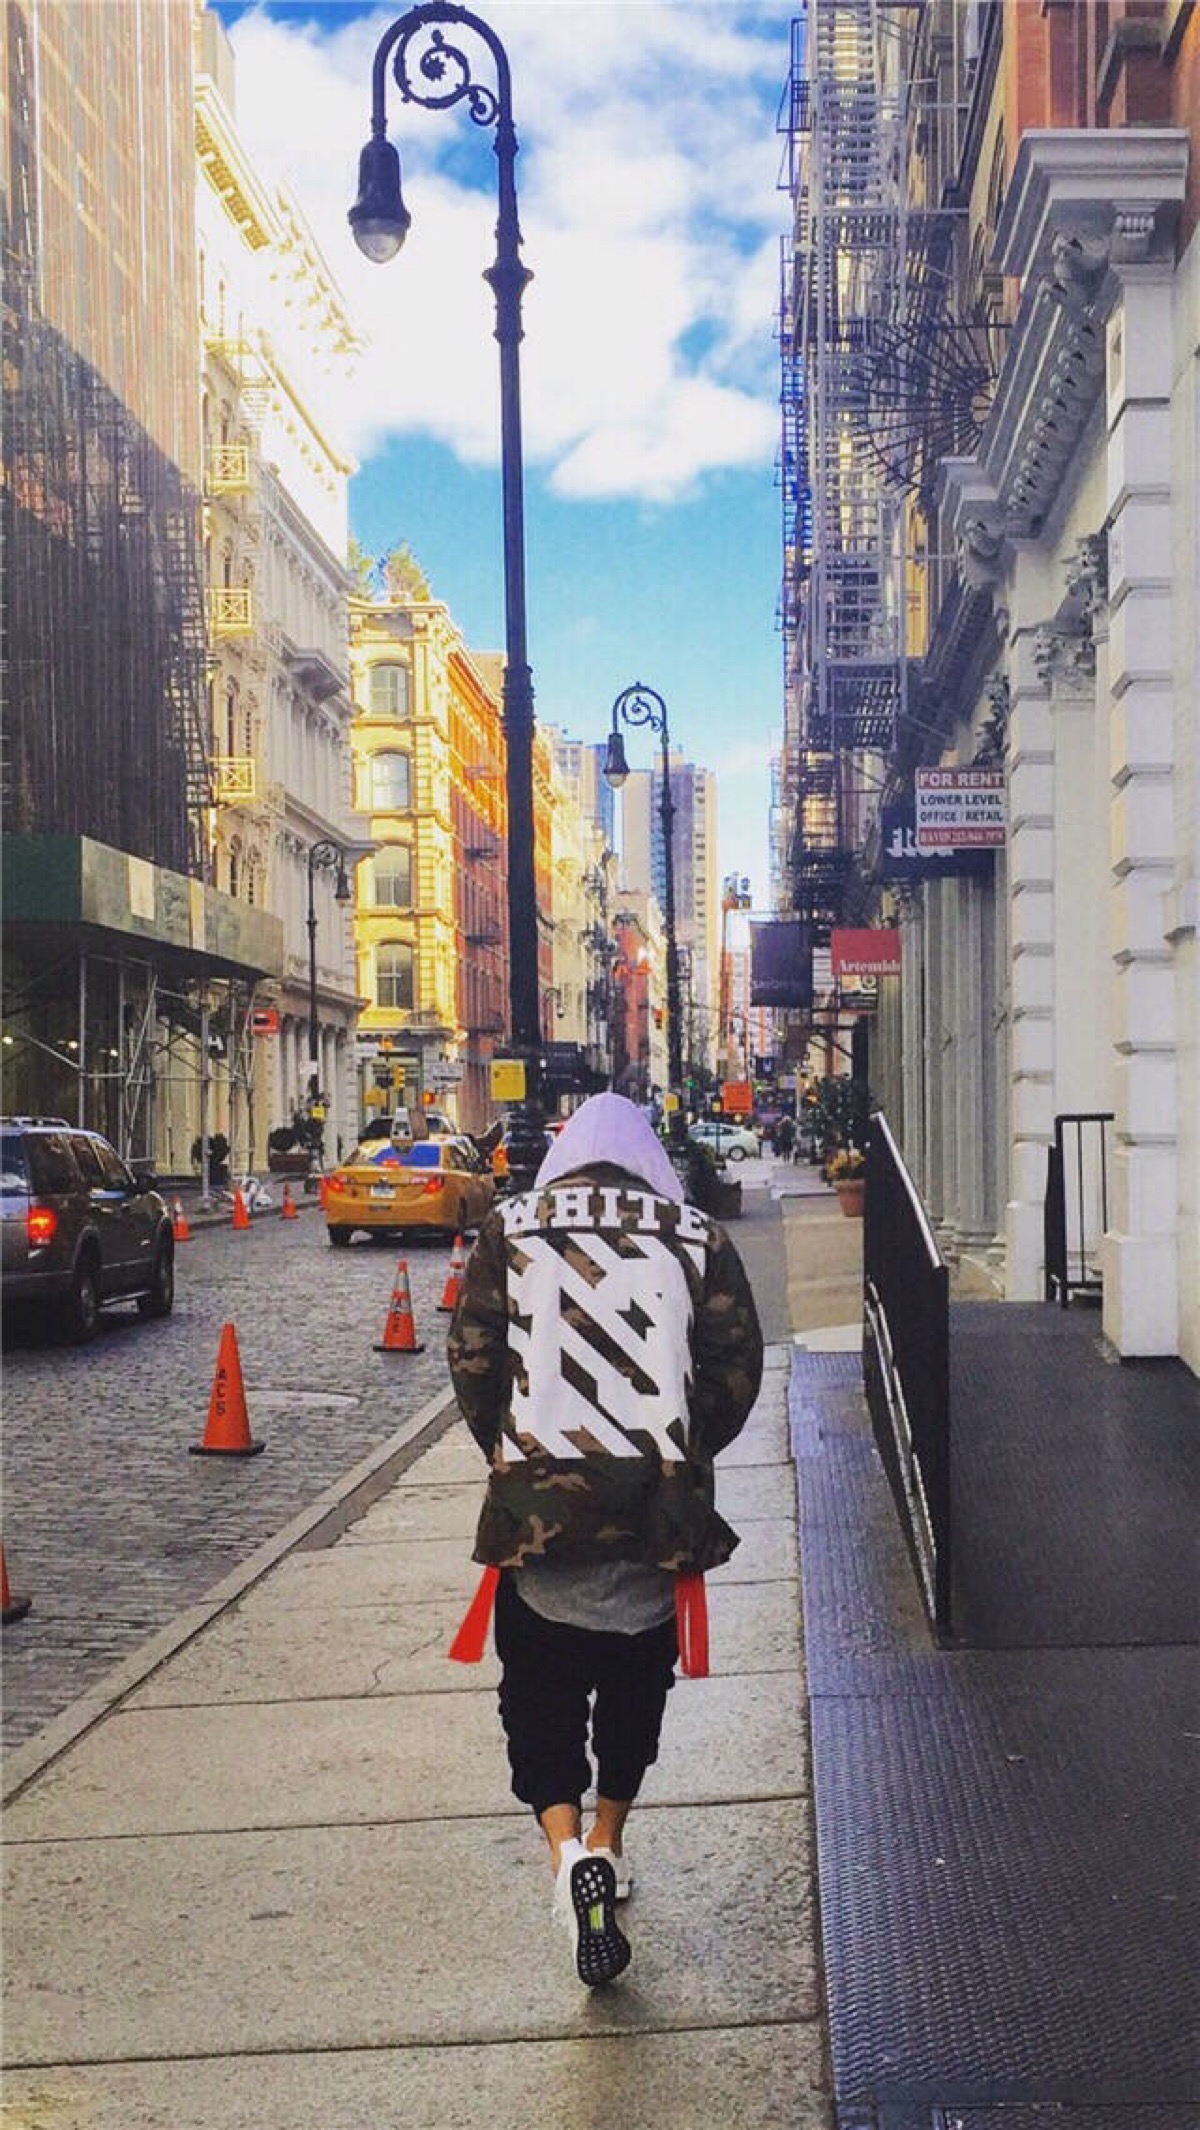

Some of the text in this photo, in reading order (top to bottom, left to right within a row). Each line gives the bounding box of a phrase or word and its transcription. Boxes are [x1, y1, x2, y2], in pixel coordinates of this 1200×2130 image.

[920, 771, 1003, 787] FOR RENT
[920, 794, 1003, 806] LOWER LEVEL
[920, 811, 956, 822] OFFICE
[965, 810, 1003, 822] RETAIL
[495, 1186, 710, 1241] WHITE
[215, 1368, 228, 1417] ACS
